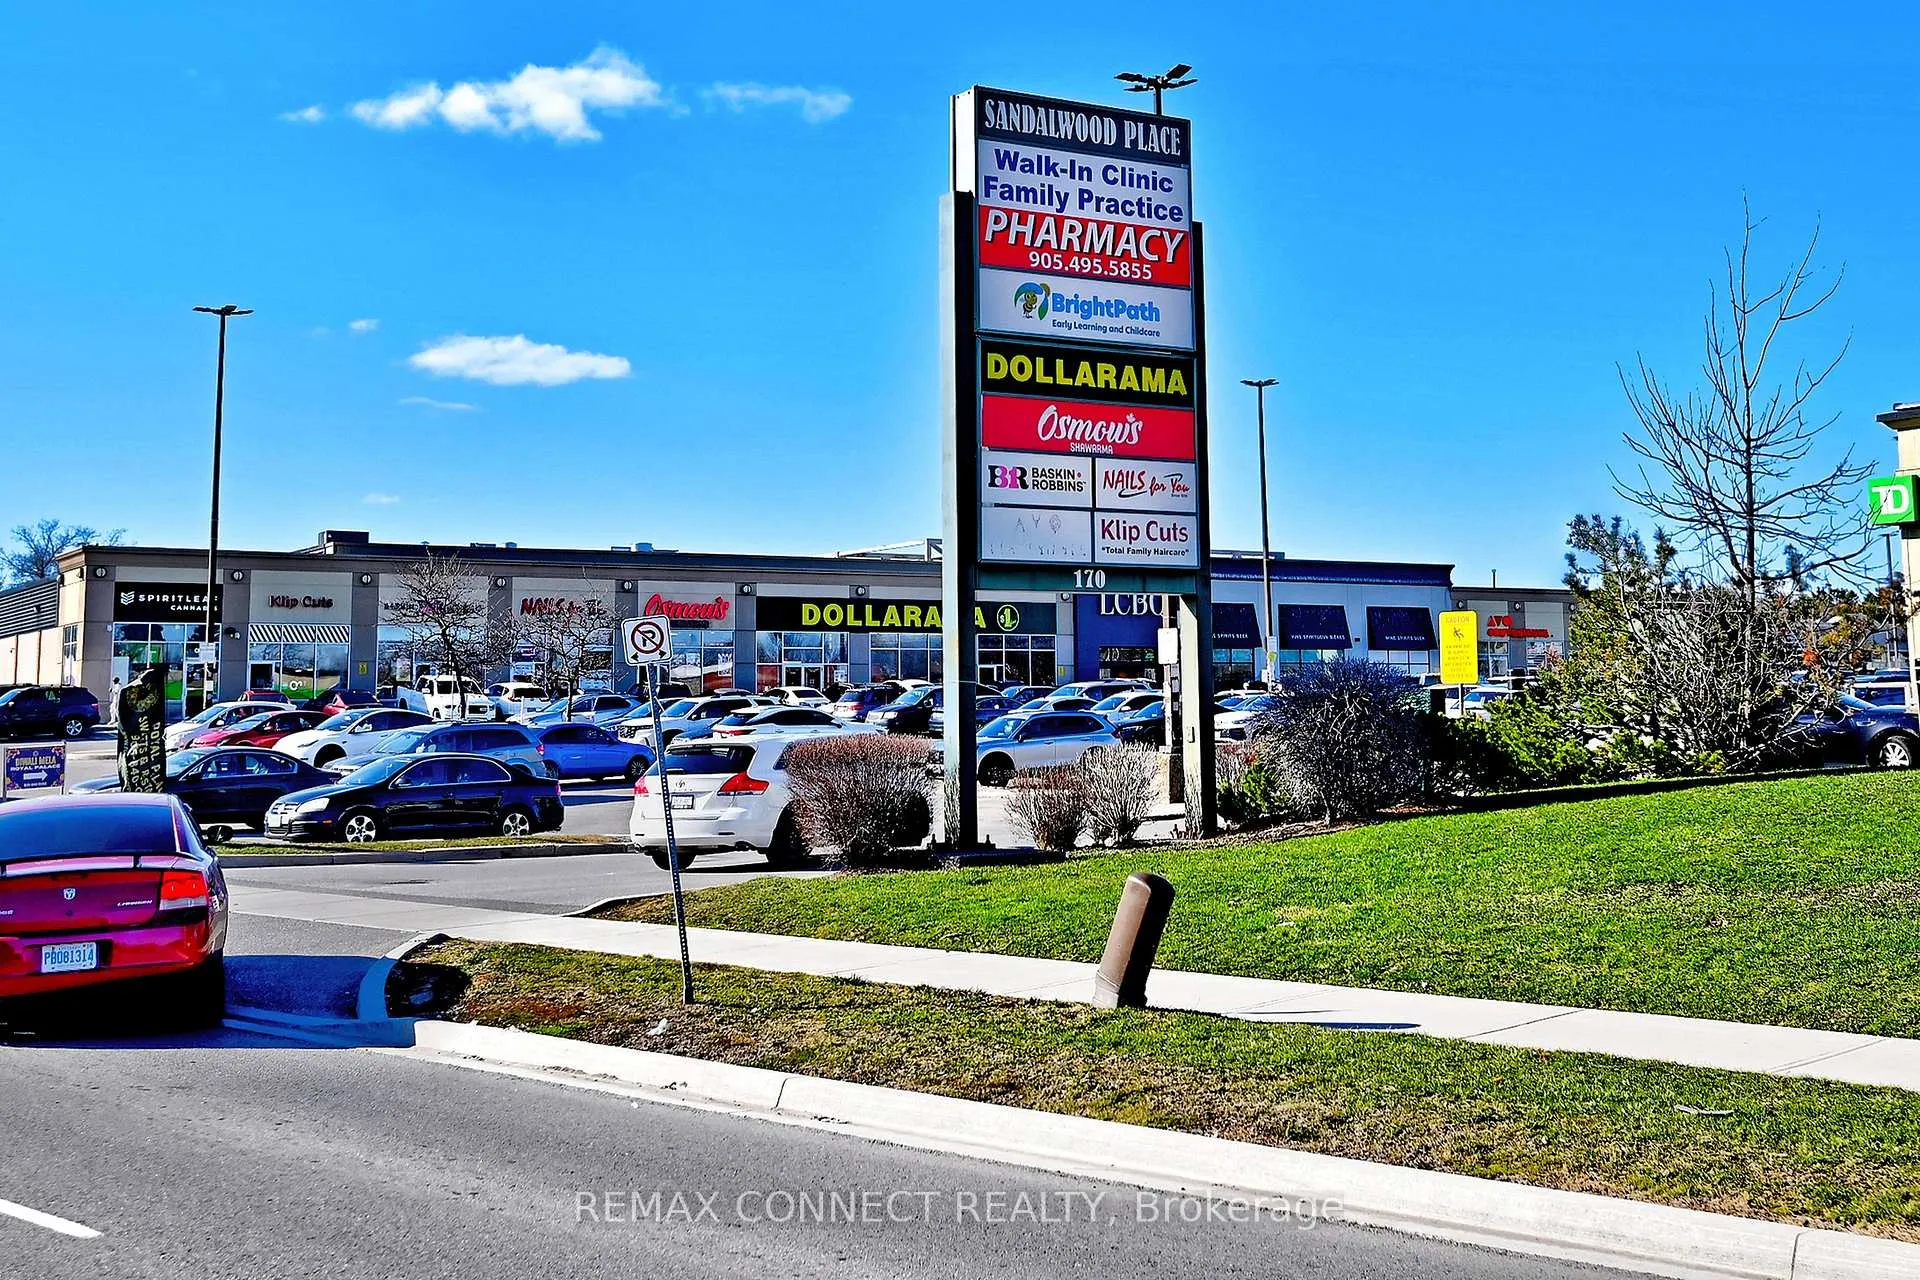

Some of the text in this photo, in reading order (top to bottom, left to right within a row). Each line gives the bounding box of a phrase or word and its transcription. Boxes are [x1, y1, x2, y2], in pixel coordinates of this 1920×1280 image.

[985, 99, 1181, 156] SANDALWOOD PLACE
[994, 148, 1174, 193] Walk-In Clinic
[983, 175, 1184, 223] Family Practice
[984, 209, 1184, 264] PHARMACY
[1029, 251, 1152, 280] 905.495.5855
[1052, 292, 1160, 322] BrightPath
[1052, 319, 1072, 330] Early
[1073, 321, 1107, 334] Learning
[1125, 326, 1160, 337] Childcare
[987, 352, 1188, 396] DOLLARAMA
[1070, 442, 1113, 455] SHAWARMA
[1031, 467, 1075, 480] BASKIN
[1032, 479, 1084, 492] ROBBINS
[1103, 469, 1190, 496] NAILS for You
[1871, 485, 1910, 515] TD
[1101, 518, 1189, 545] Klip Cuts
[1127, 547, 1152, 556] Family
[1074, 569, 1106, 588] 170
[270, 595, 299, 609] Klip
[802, 603, 987, 629] DOLLARAA
